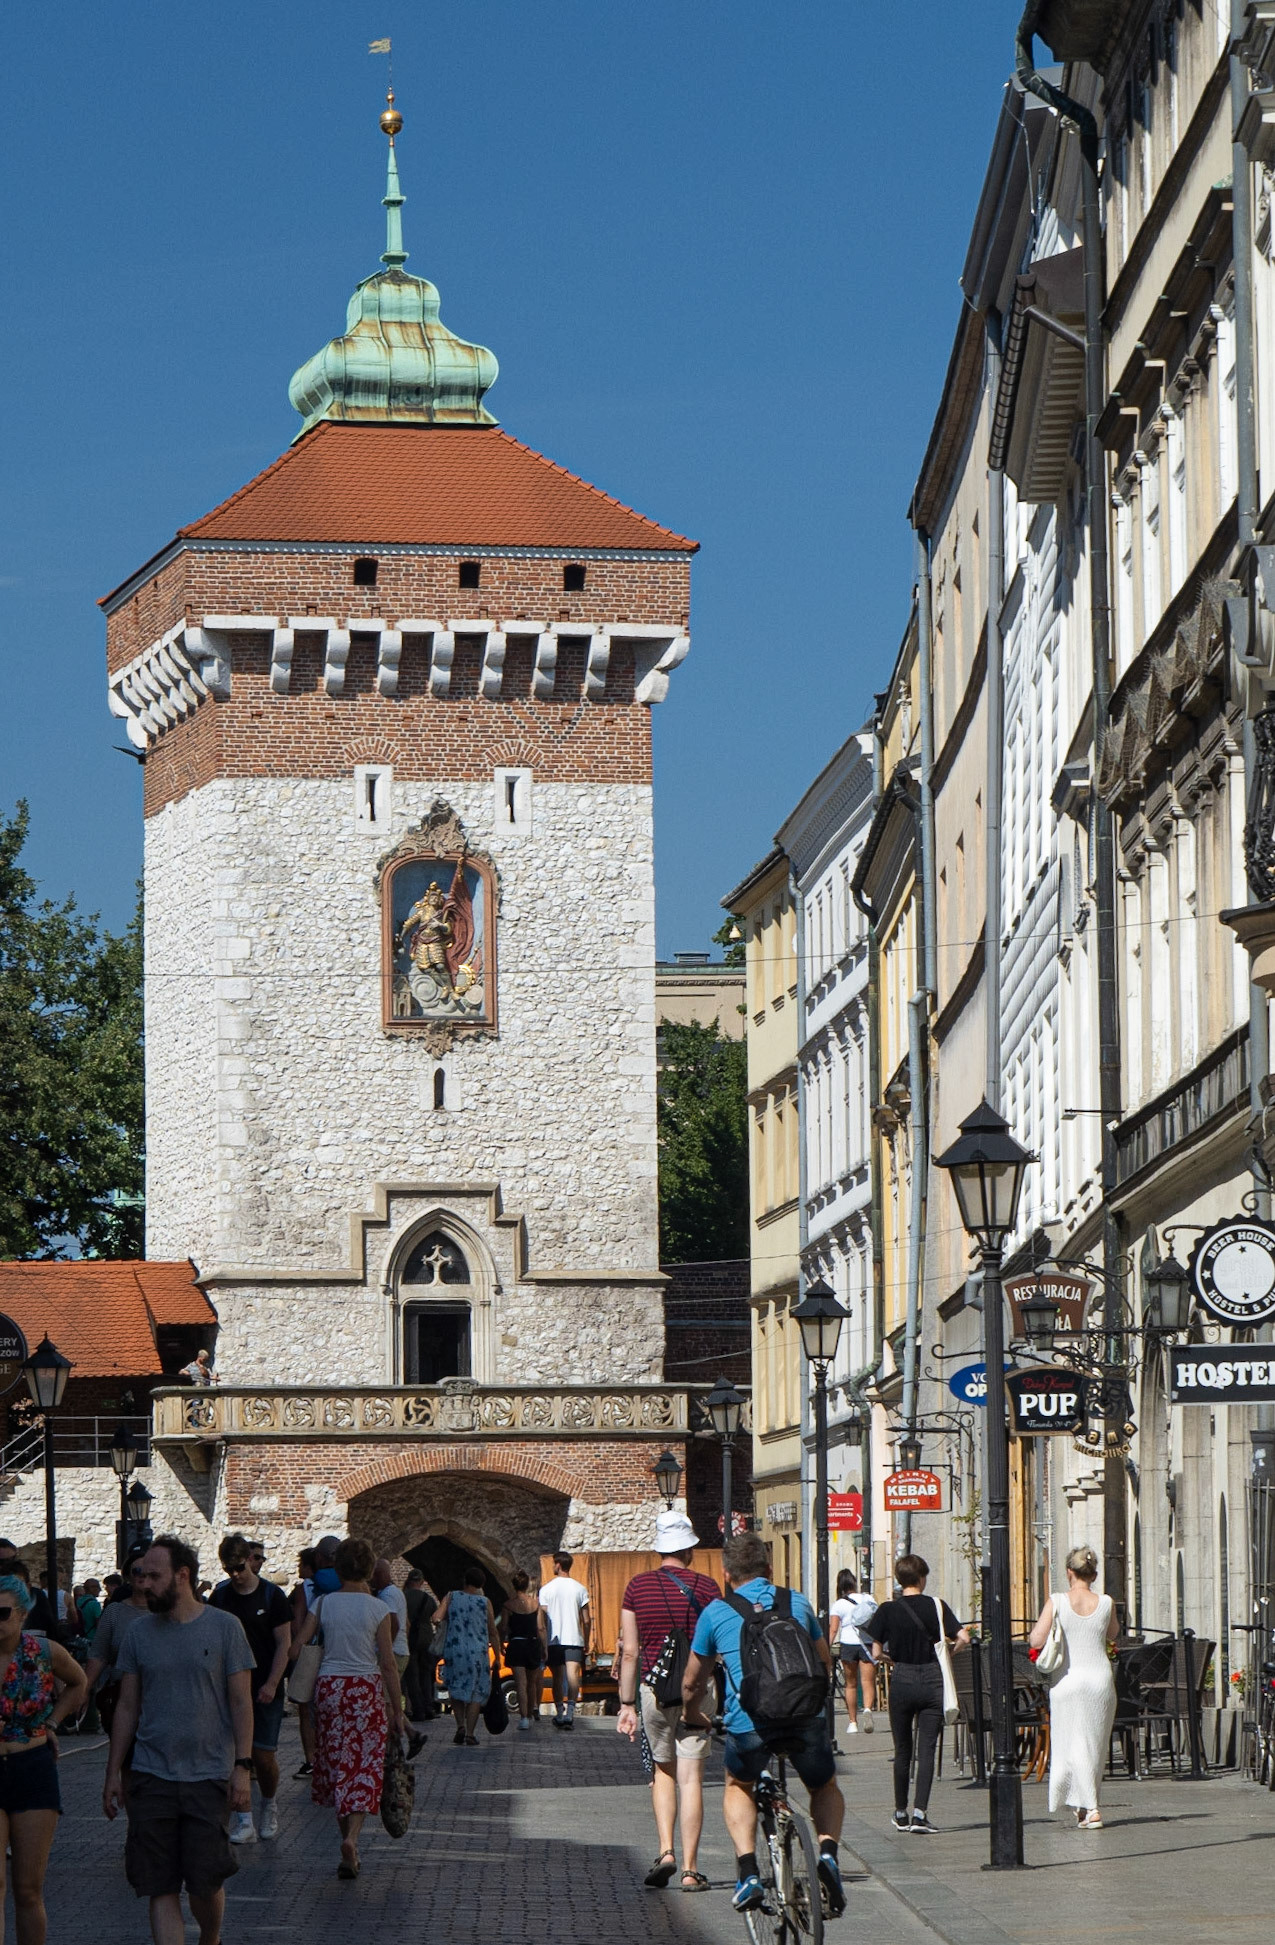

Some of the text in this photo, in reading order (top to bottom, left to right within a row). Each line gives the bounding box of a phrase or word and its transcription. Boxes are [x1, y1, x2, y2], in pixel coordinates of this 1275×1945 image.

[1207, 1231, 1275, 1258] BEER HOUSE
[1013, 1284, 1081, 1301] RESTURACJA
[1208, 1287, 1275, 1314] HOSTEL & PU
[887, 1484, 938, 1496] KEBAB
[889, 1498, 920, 1506] FALAFEL
